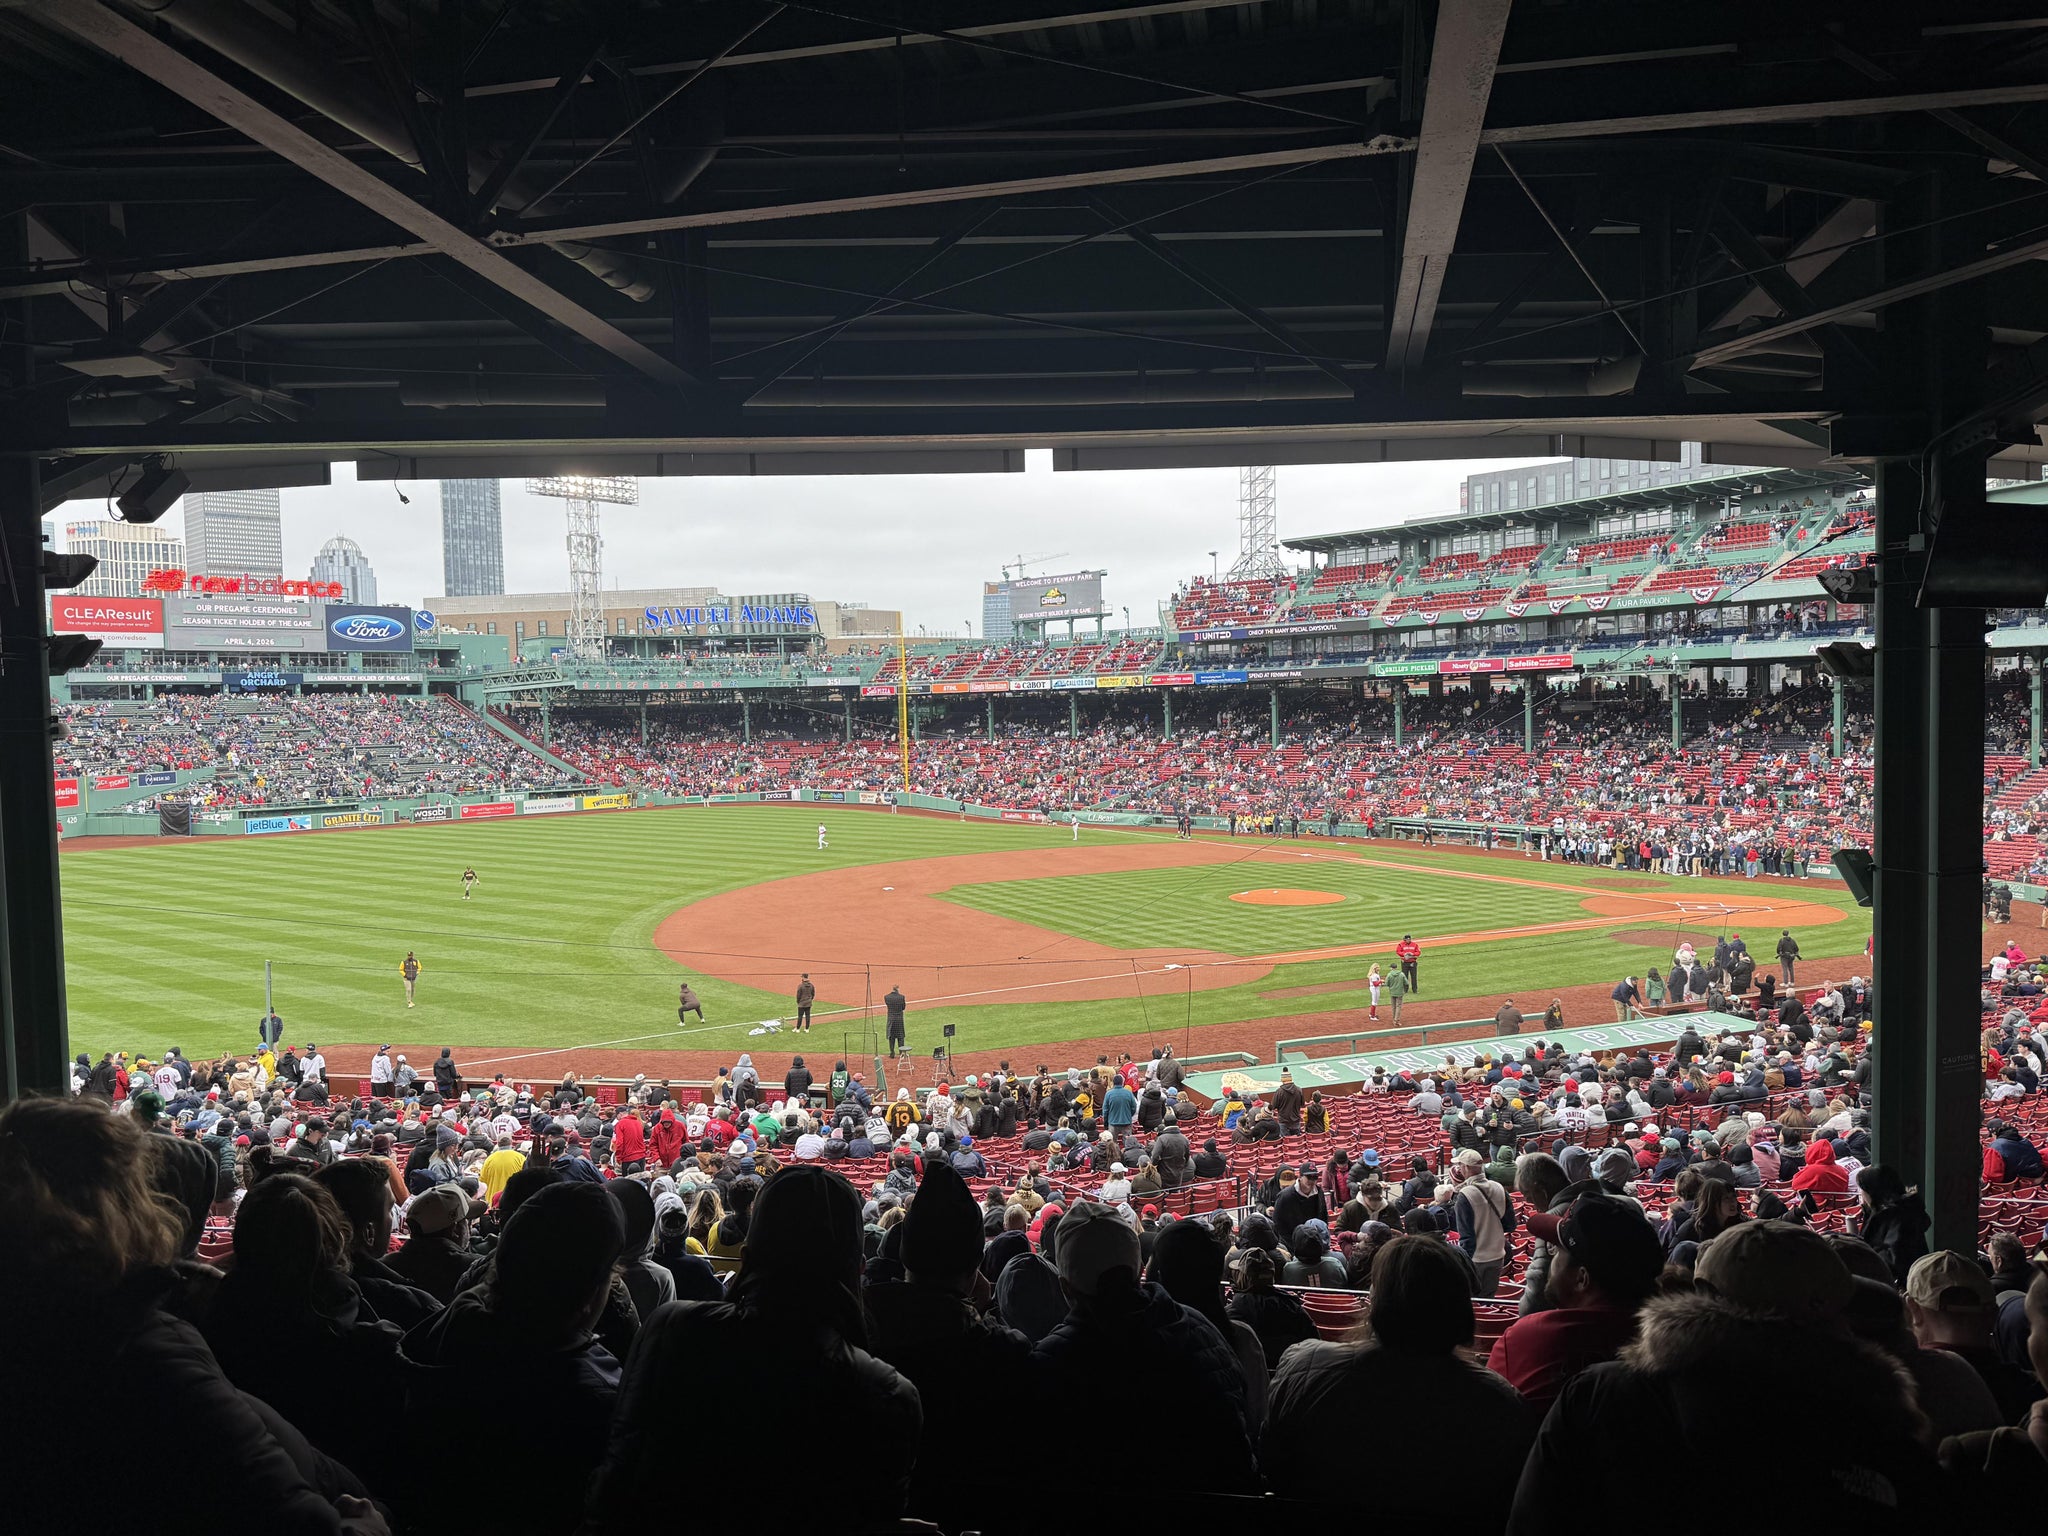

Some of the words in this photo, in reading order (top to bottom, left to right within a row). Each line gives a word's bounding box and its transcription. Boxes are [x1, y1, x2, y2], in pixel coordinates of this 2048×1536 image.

[244, 573, 343, 598] balance
[1640, 597, 1670, 606] PAVILION
[64, 607, 152, 621] CLEAResult
[645, 605, 735, 630] SAMUEL
[739, 604, 816, 626] ADAMS
[346, 618, 390, 637] Ford
[1202, 631, 1231, 640] UNITED
[246, 671, 279, 679] ANGRY
[240, 678, 287, 686] ORCHARD
[592, 799, 613, 807] TWISTED
[415, 807, 446, 817] wasabi
[66, 816, 78, 824] 420
[324, 813, 362, 826] GRANITE
[363, 812, 381, 824] CITY
[249, 819, 284, 832] jetBlue
[158, 1074, 171, 1084] 19
[833, 1080, 845, 1088] 33
[865, 1119, 883, 1130] 30
[895, 1112, 911, 1127] 19
[707, 1130, 723, 1143] 34
